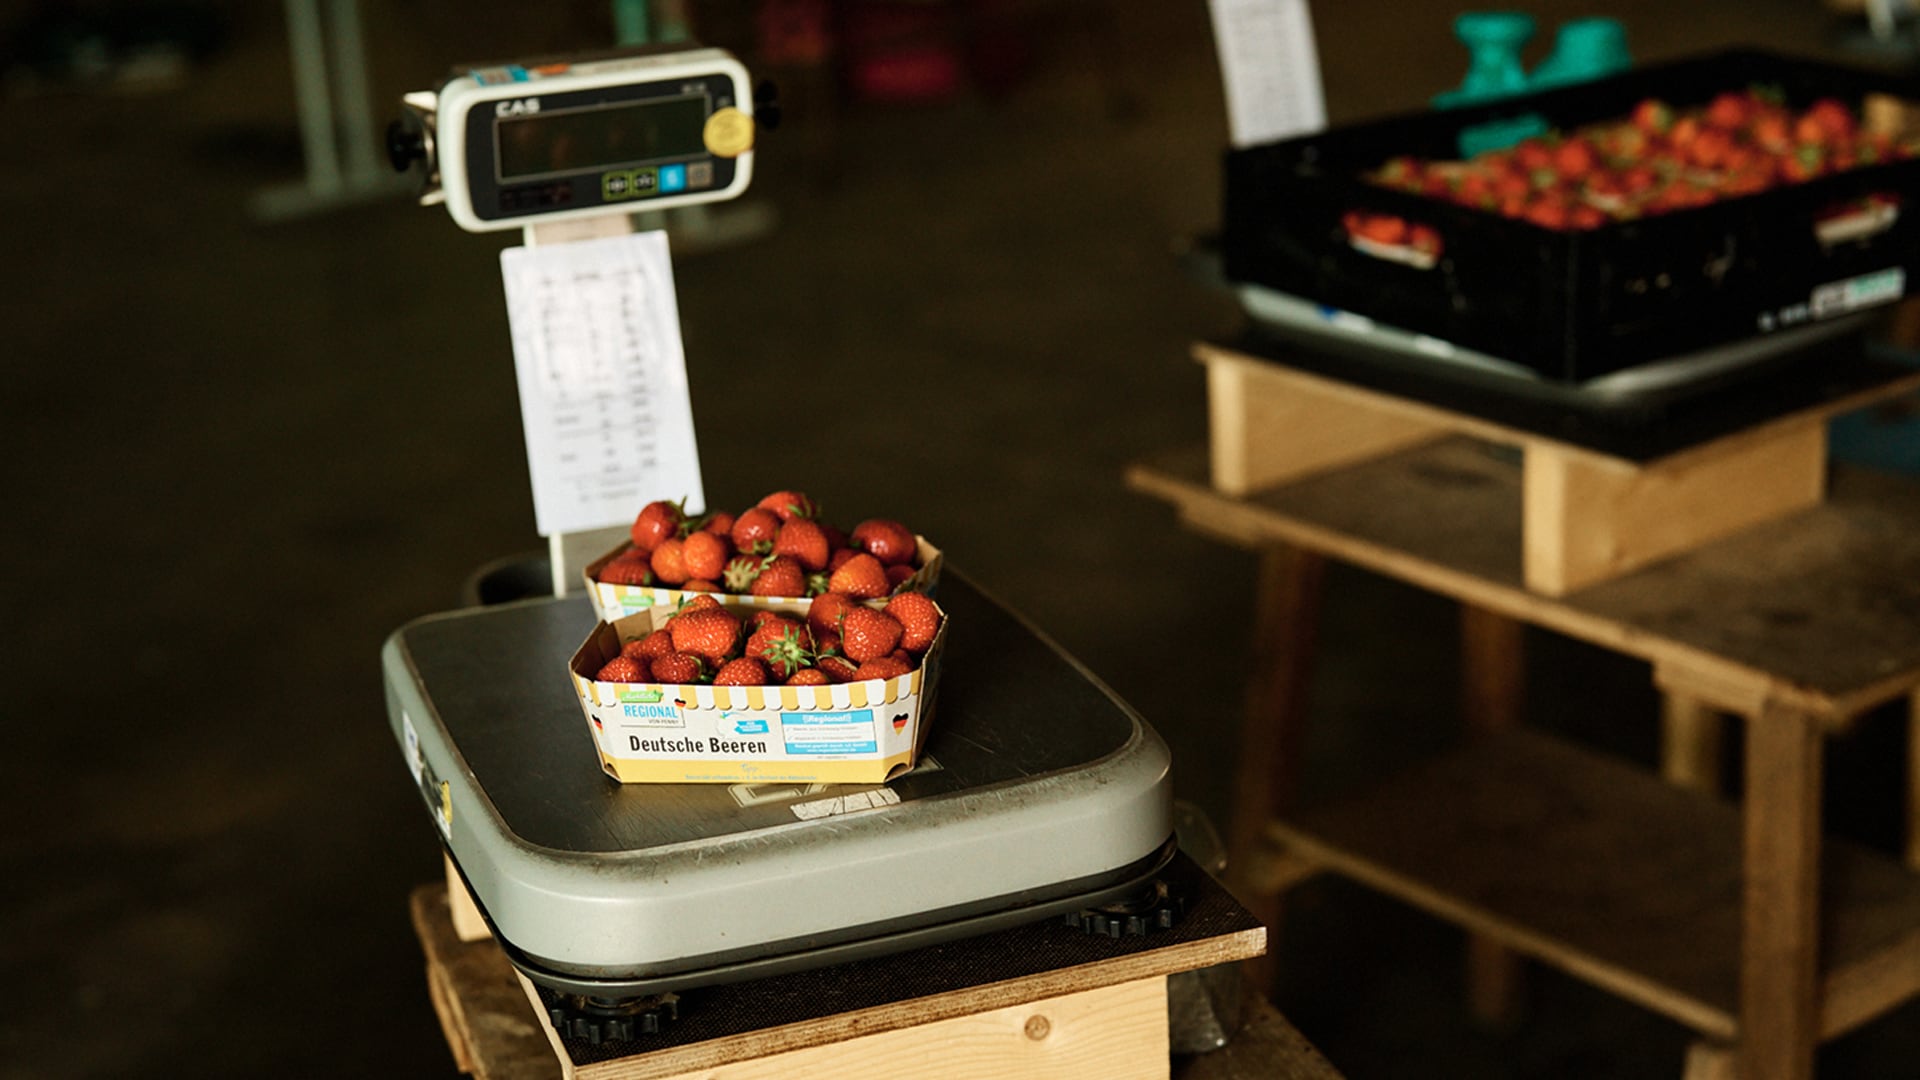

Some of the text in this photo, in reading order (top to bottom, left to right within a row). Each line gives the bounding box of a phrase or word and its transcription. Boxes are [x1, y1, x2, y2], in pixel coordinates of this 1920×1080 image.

[496, 98, 540, 117] CAS
[624, 705, 678, 719] REGIONAL
[629, 735, 767, 754] Deutsche Beeren
